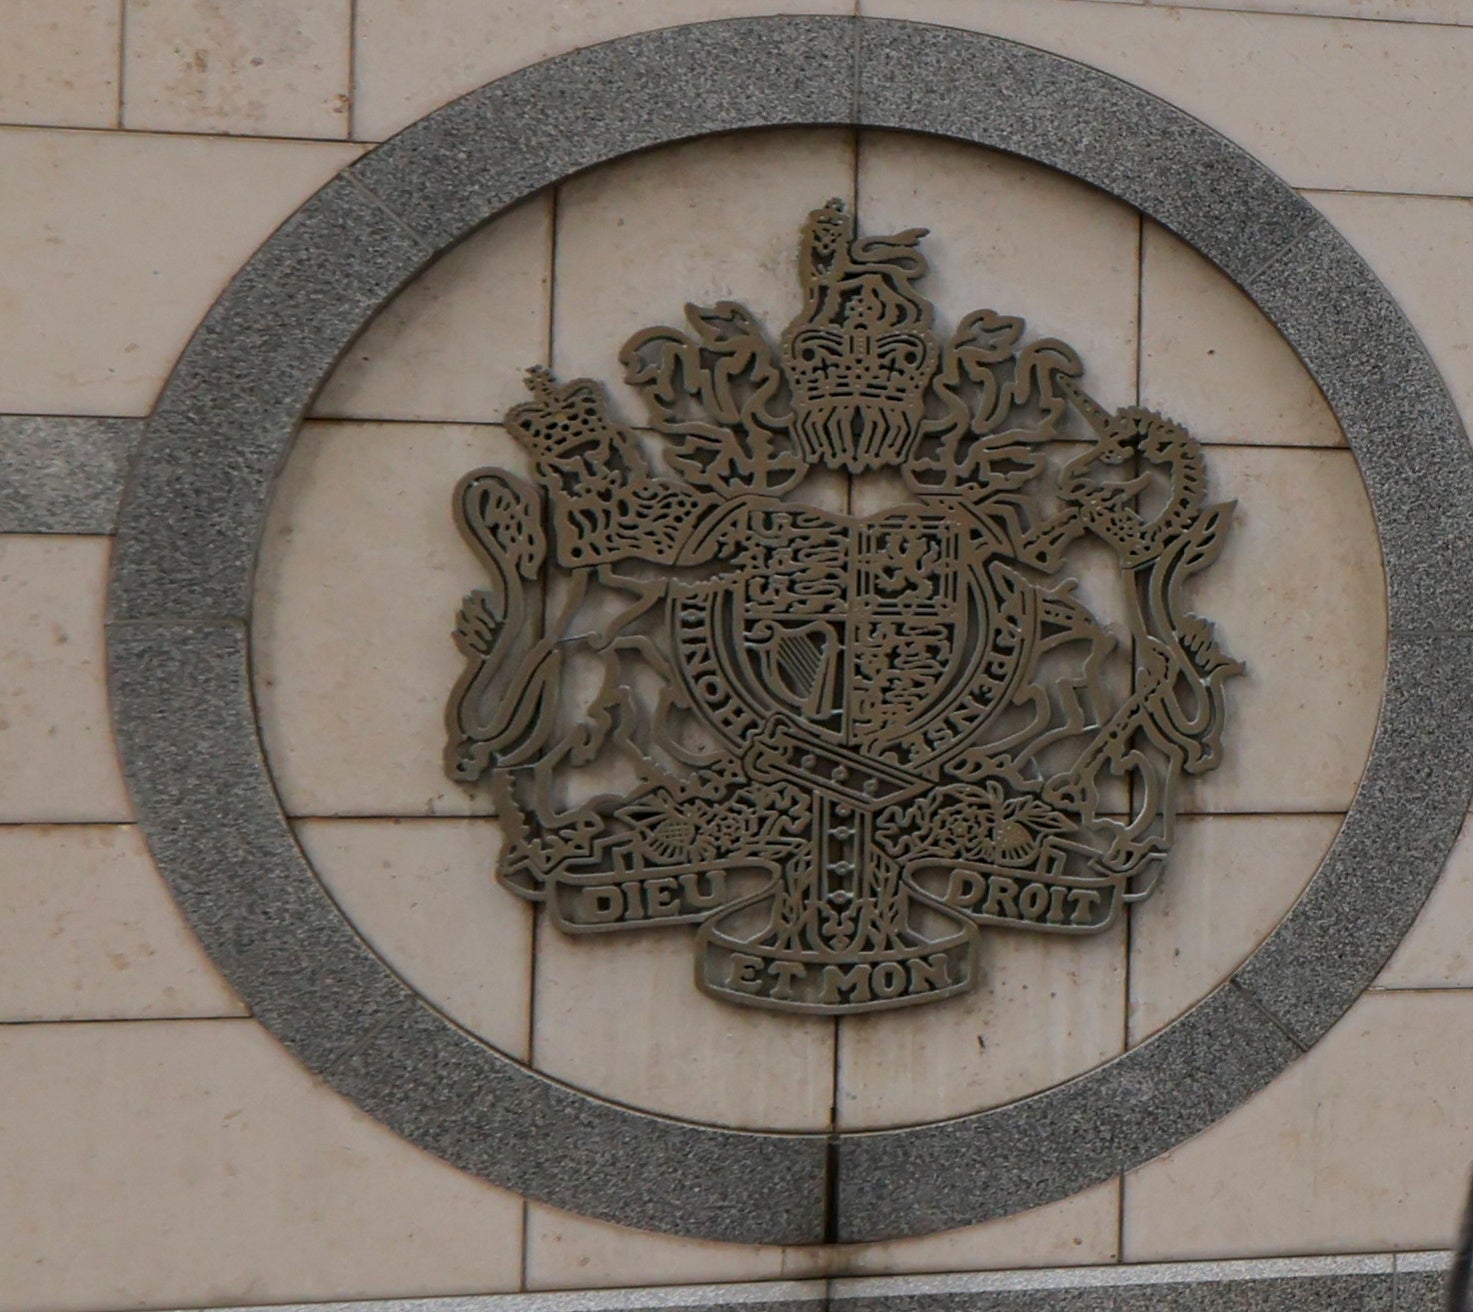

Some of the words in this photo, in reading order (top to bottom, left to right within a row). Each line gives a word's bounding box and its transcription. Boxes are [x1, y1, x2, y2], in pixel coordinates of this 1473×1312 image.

[576, 871, 726, 923] DIEU
[725, 952, 806, 1000] ET
[820, 953, 952, 1003] MON
[945, 869, 1100, 926] DROIT
